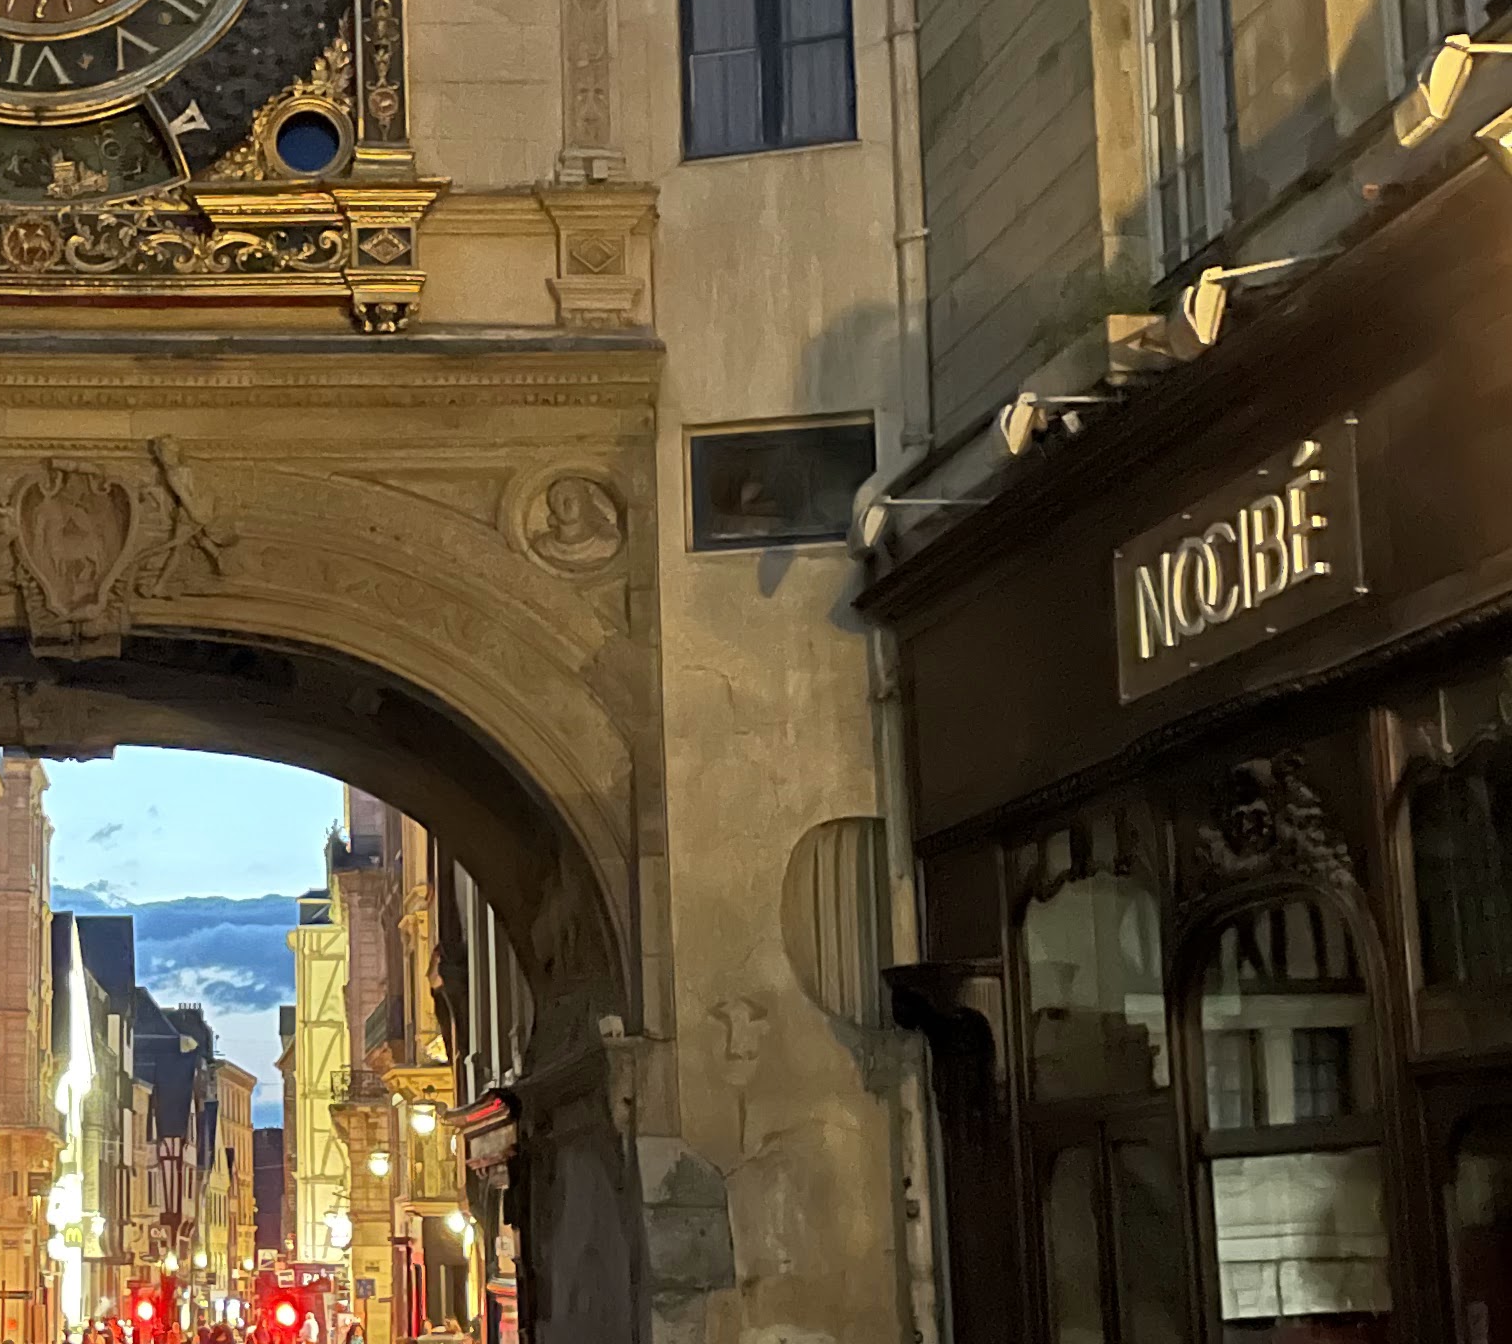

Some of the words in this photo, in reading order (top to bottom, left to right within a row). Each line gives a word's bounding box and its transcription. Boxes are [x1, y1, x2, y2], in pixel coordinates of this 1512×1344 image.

[6, 43, 73, 86] VI
[116, 26, 161, 71] V
[1137, 440, 1331, 659] NOCIBÉ
